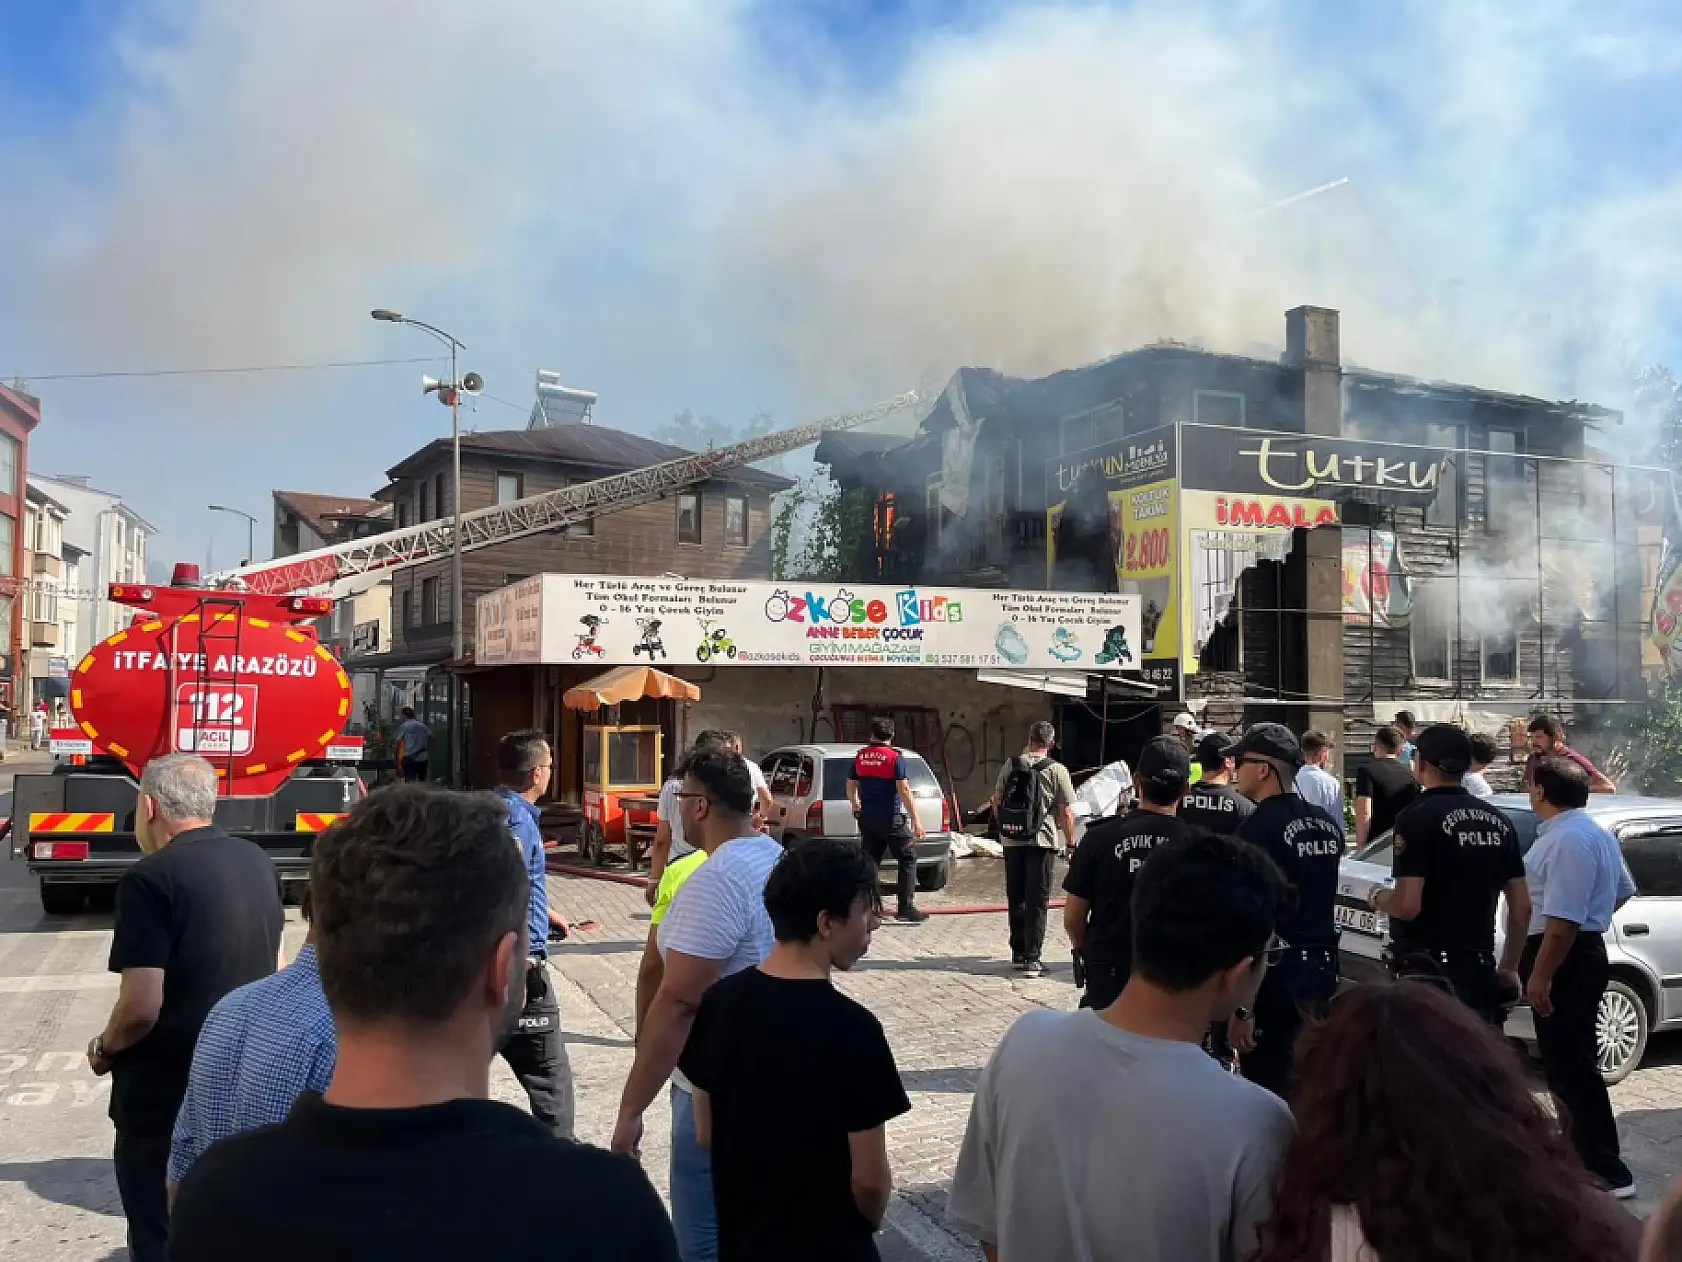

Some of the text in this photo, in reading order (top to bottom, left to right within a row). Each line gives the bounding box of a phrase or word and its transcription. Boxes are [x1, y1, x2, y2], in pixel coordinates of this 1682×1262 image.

[574, 579, 595, 590] Her
[882, 627, 925, 642] ÇOCUK
[213, 653, 318, 678] ARAZÖZÜ
[190, 691, 244, 726] 112
